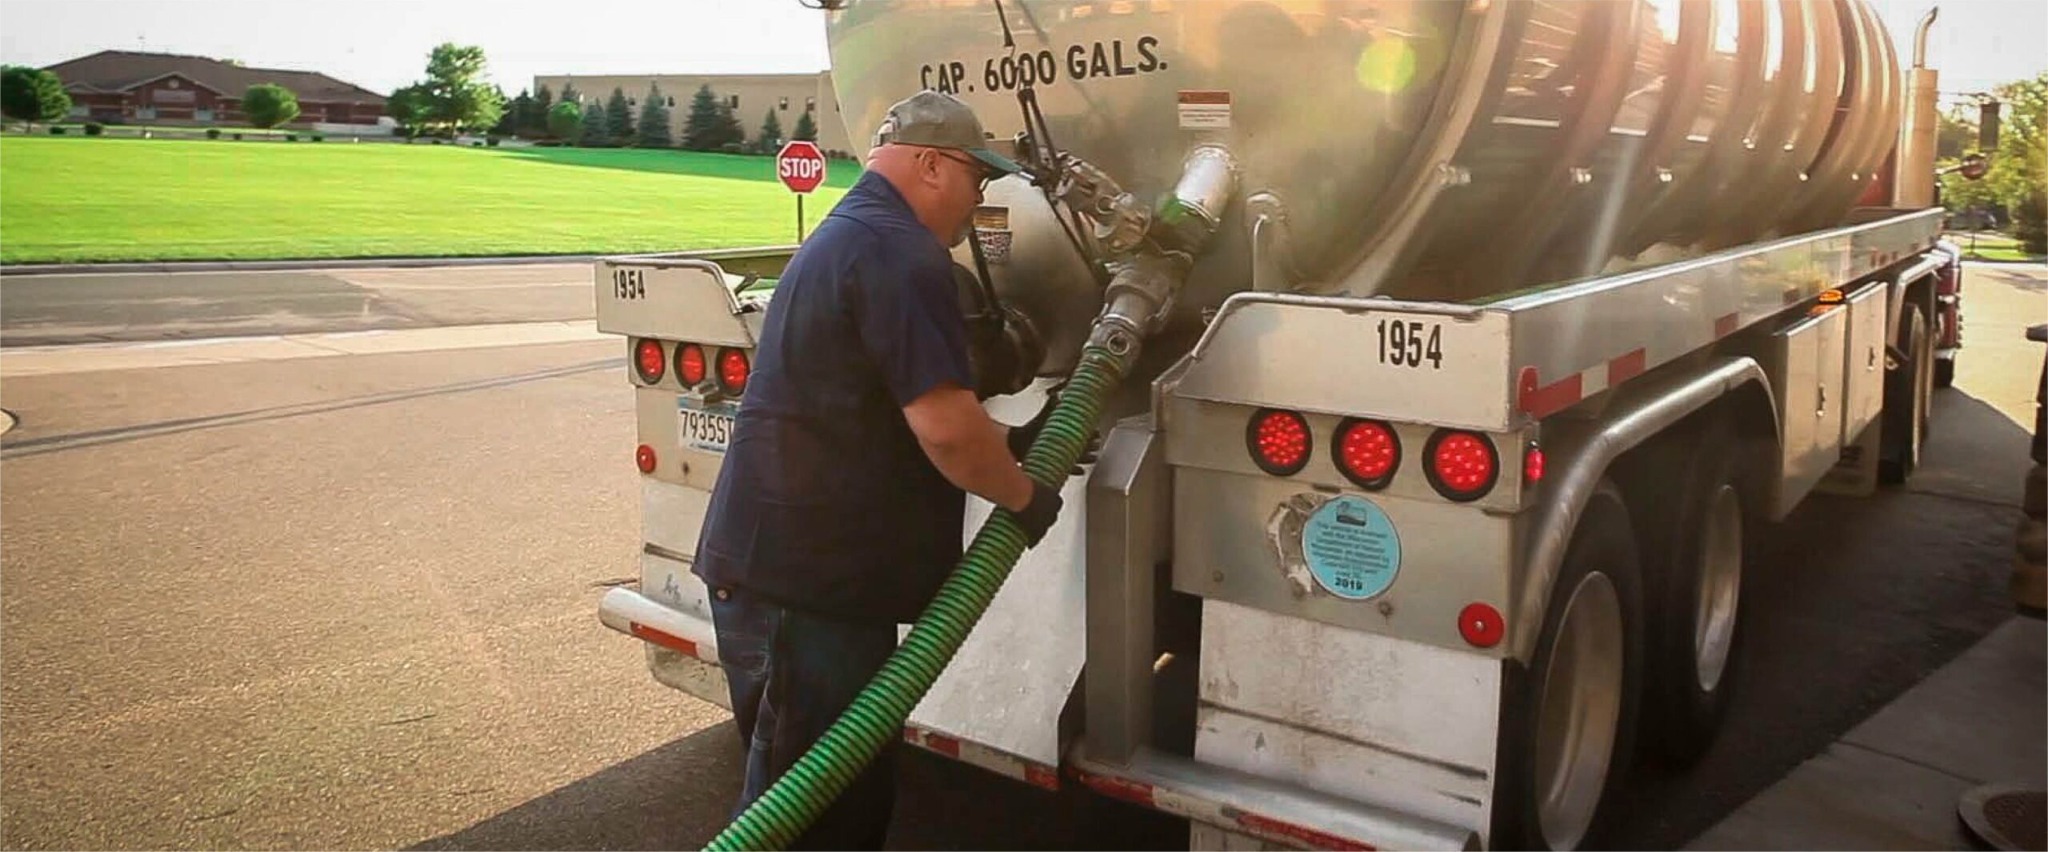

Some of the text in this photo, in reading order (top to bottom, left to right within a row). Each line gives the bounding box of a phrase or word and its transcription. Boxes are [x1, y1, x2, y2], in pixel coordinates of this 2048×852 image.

[921, 36, 1168, 95] CAP. 6000 GALS.
[780, 157, 822, 178] STOP
[613, 269, 645, 299] 1954
[1377, 319, 1442, 369] 1954
